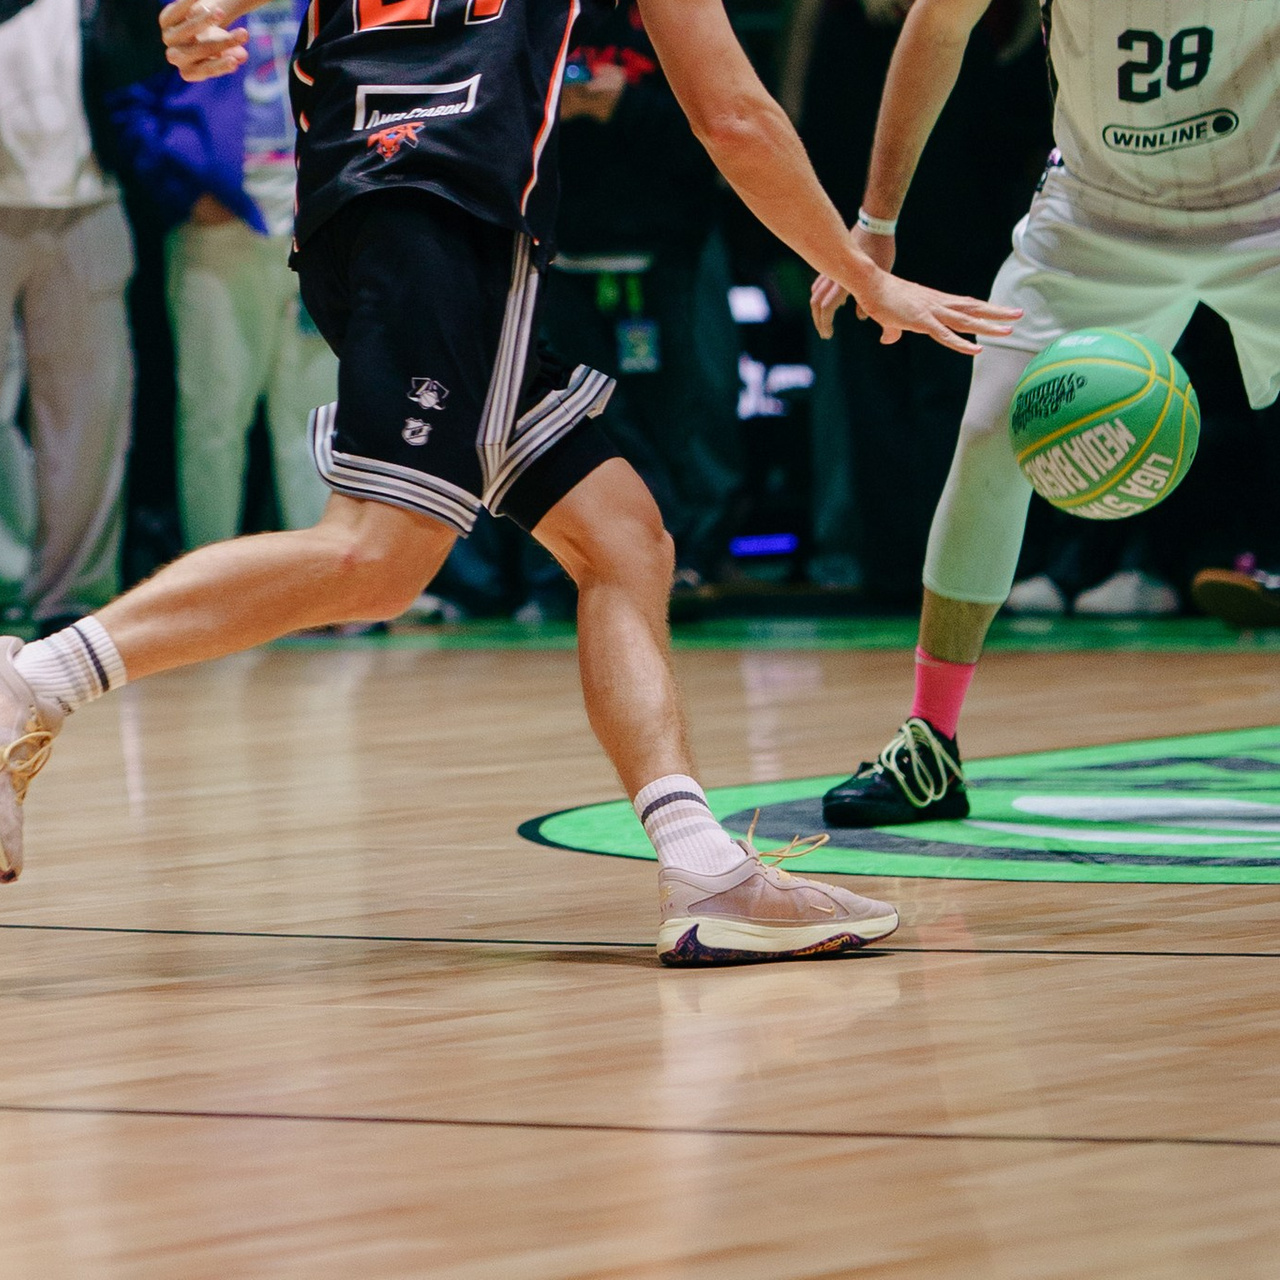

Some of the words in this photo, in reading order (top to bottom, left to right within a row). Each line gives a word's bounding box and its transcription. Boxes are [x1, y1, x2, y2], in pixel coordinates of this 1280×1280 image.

[1117, 26, 1214, 104] 28
[1113, 121, 1208, 149] WINLINE
[1062, 417, 1137, 482] MEDIA
[1117, 452, 1173, 500] LIGA
